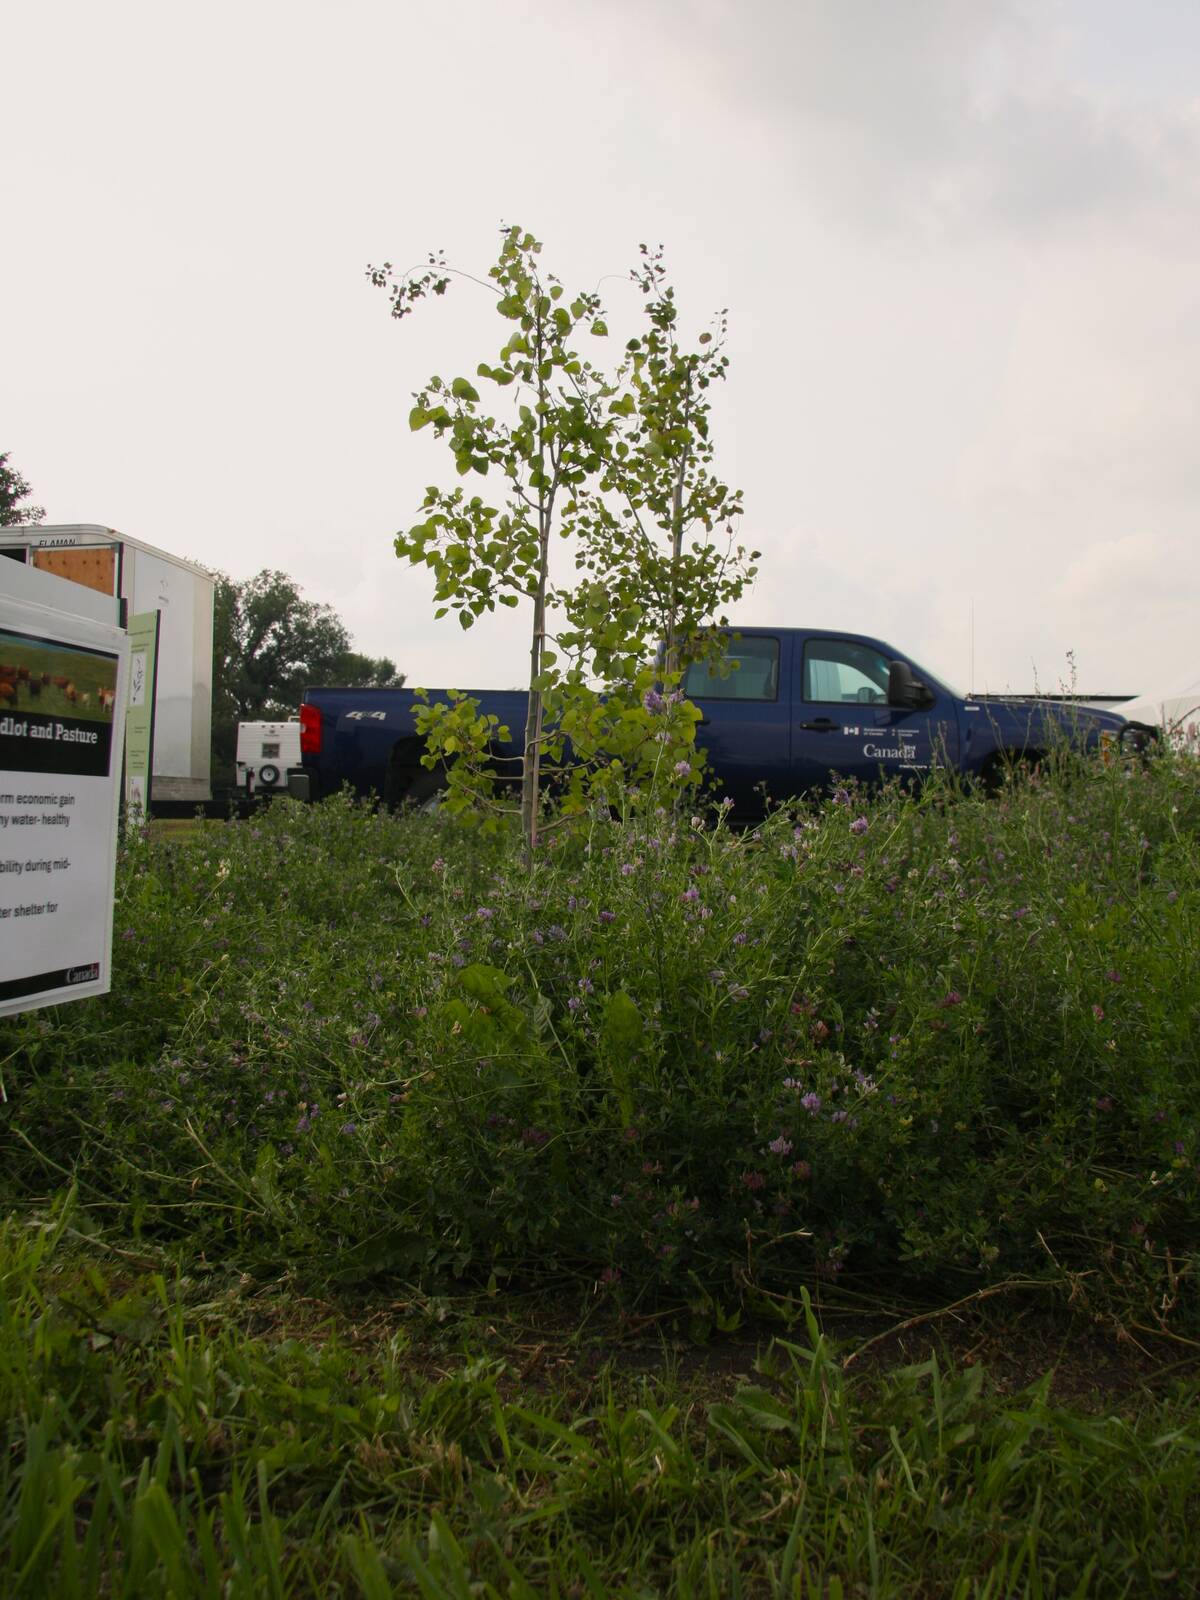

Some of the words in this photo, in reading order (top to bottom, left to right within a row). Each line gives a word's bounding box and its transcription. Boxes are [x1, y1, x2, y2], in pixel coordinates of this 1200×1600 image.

[30, 722, 53, 740] and
[55, 723, 98, 744] Pasture
[863, 743, 916, 759] Canada
[16, 793, 58, 805] economic
[59, 792, 75, 808] gain
[42, 812, 71, 828] healthy
[25, 859, 52, 873] during
[14, 903, 46, 918] shelter
[46, 901, 59, 914] for
